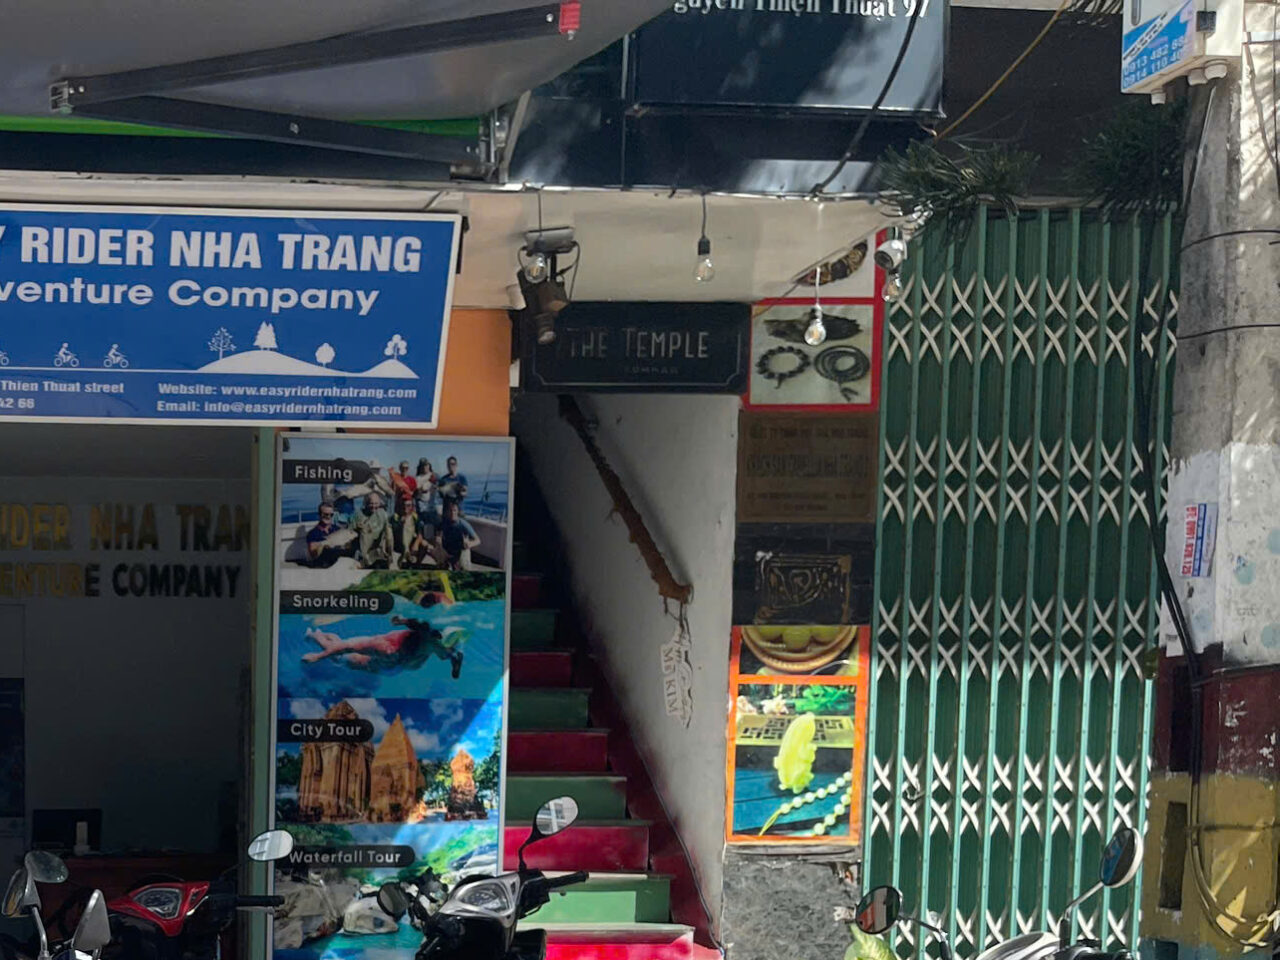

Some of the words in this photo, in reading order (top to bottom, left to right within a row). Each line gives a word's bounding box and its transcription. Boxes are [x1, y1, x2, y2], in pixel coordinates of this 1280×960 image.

[21, 225, 155, 267] RIDER
[170, 229, 262, 271] NHA
[277, 233, 422, 274] TRANG
[168, 278, 380, 316] Company
[567, 327, 608, 358] THE
[622, 327, 709, 359] TEMPLE
[1, 380, 39, 392] Thien
[42, 380, 81, 392] Thuat
[84, 382, 125, 394] street
[158, 383, 217, 395] Website:
[221, 385, 417, 399] www.easyridernhatrang.com
[157, 401, 201, 413] Email:
[204, 401, 402, 415] info@easyridernhatrang.com
[294, 465, 353, 482] Fishing
[90, 502, 159, 551] NHA
[175, 503, 252, 552] TRAN
[112, 563, 242, 598] COMPANY
[292, 594, 380, 611] Snorkeling
[290, 723, 323, 737] City
[328, 723, 361, 736] Tour
[289, 850, 363, 864] Waterfall
[368, 851, 401, 864] Tour
